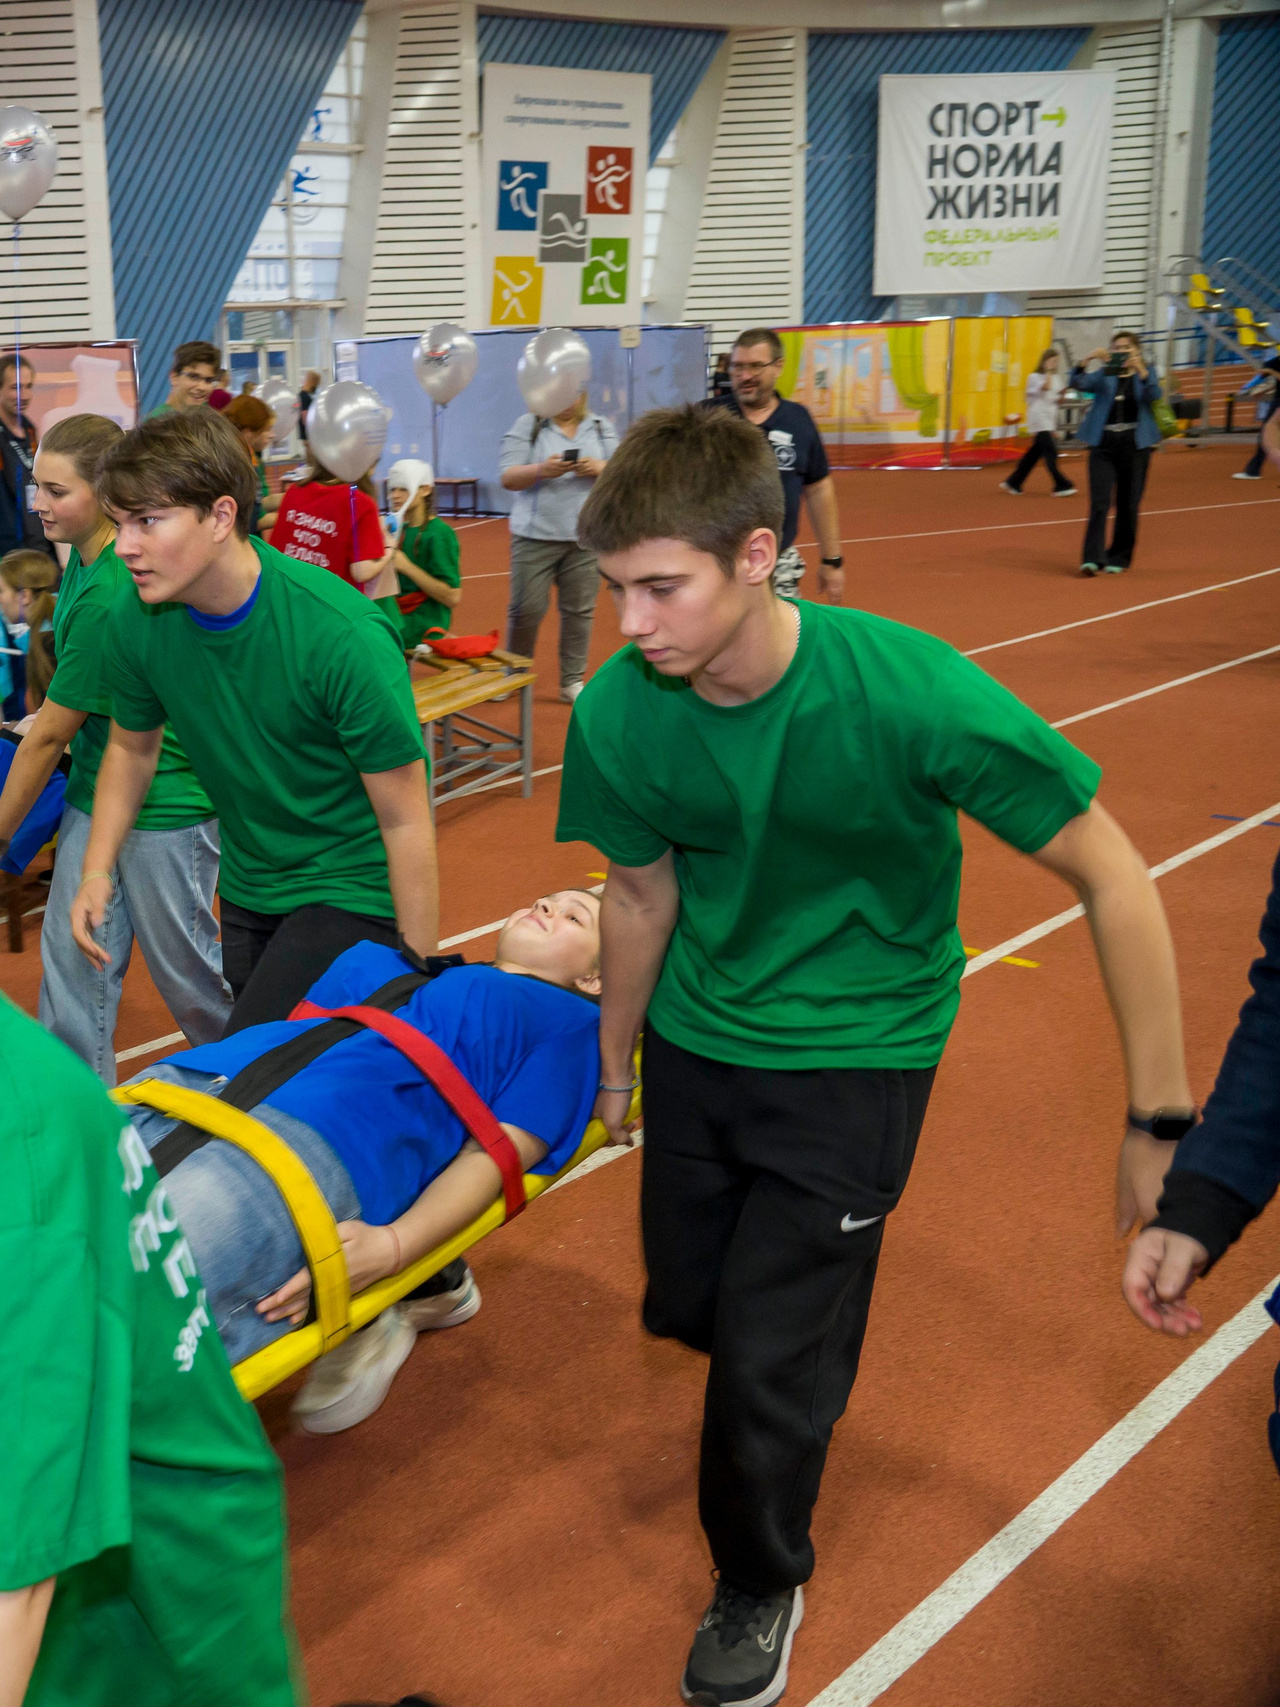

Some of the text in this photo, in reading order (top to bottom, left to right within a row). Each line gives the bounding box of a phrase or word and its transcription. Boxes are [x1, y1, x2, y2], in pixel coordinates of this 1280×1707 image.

[928, 100, 1042, 138] СПОРТ
[927, 141, 1063, 179] НОРМА
[925, 182, 1061, 220] ЖИЗНИ
[923, 222, 1060, 244] ФЕДЕРАЛЬНЫЙ
[923, 250, 992, 267] ПРОЕКТ
[293, 528, 322, 548] ЧТО
[283, 542, 331, 568] ЕЛАТЬ
